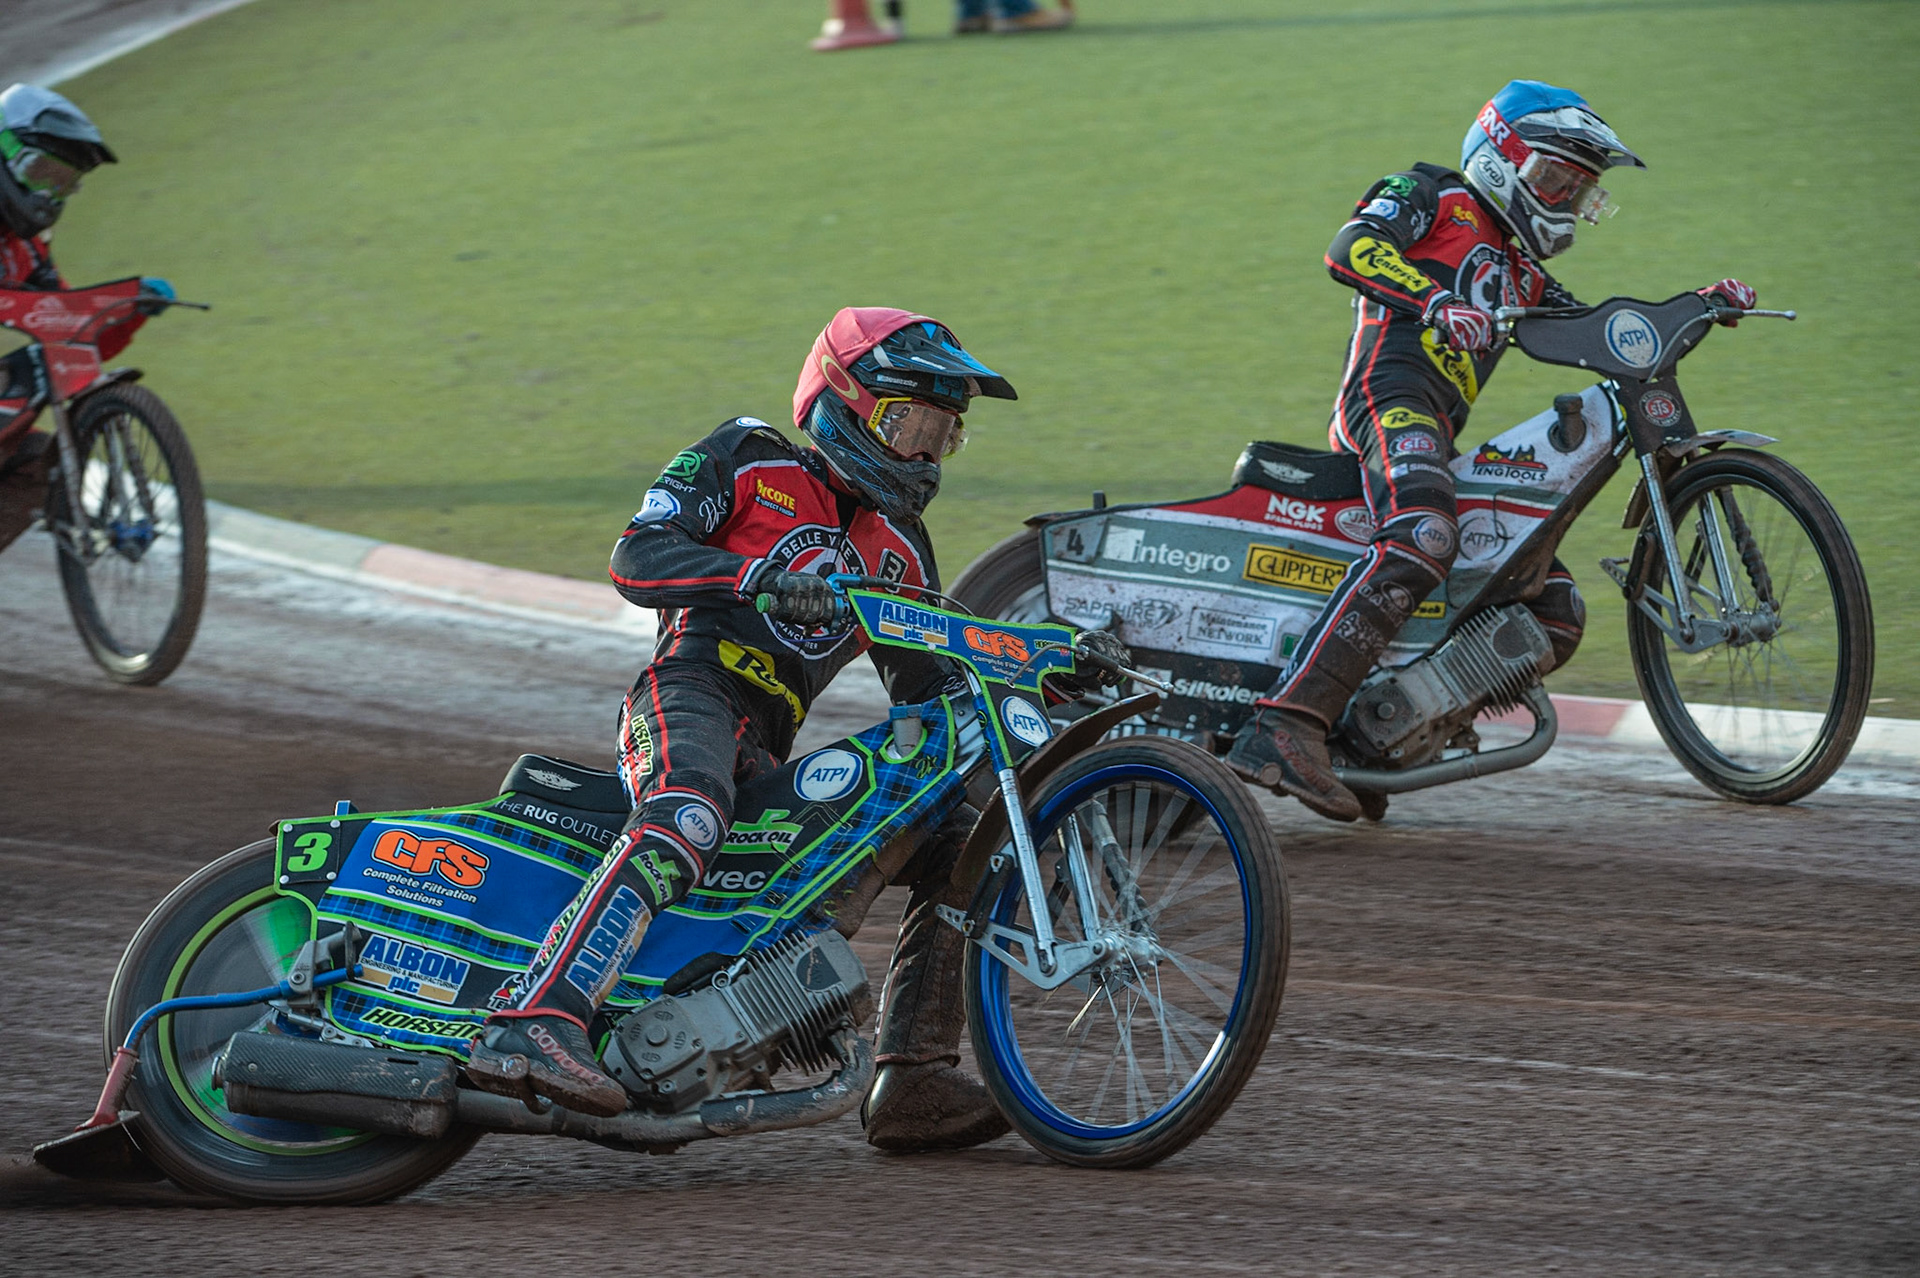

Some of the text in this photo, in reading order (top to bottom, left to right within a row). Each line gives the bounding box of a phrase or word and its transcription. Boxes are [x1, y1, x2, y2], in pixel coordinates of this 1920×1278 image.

[1480, 159, 1502, 184] Arai
[1619, 329, 1650, 348] ATPI
[1268, 493, 1327, 523] NGK
[781, 532, 821, 559] BELLE
[1066, 528, 1085, 556] 4
[1463, 531, 1500, 548] ATPI
[1132, 539, 1231, 574] integro
[881, 602, 947, 632] ALBON
[904, 629, 923, 640] plc
[963, 626, 1030, 663] CFS
[1013, 713, 1042, 734] ATPI
[806, 767, 850, 782] ATPI
[523, 805, 558, 825] RUG
[560, 816, 620, 847] OUTLET
[685, 812, 711, 839] ATPI
[725, 831, 793, 844] ROCK OIL
[287, 832, 333, 872] 3
[373, 829, 489, 888] CFS
[362, 867, 478, 904] Complete Filtration
[640, 853, 670, 902] ROCK OIL
[386, 884, 444, 907] Solutions
[566, 886, 643, 998] ALBON
[360, 957, 402, 975] ENGINEERING
[407, 971, 460, 991] MANUFACTURING
[361, 935, 469, 985] ALBON
[388, 975, 420, 994] plc
